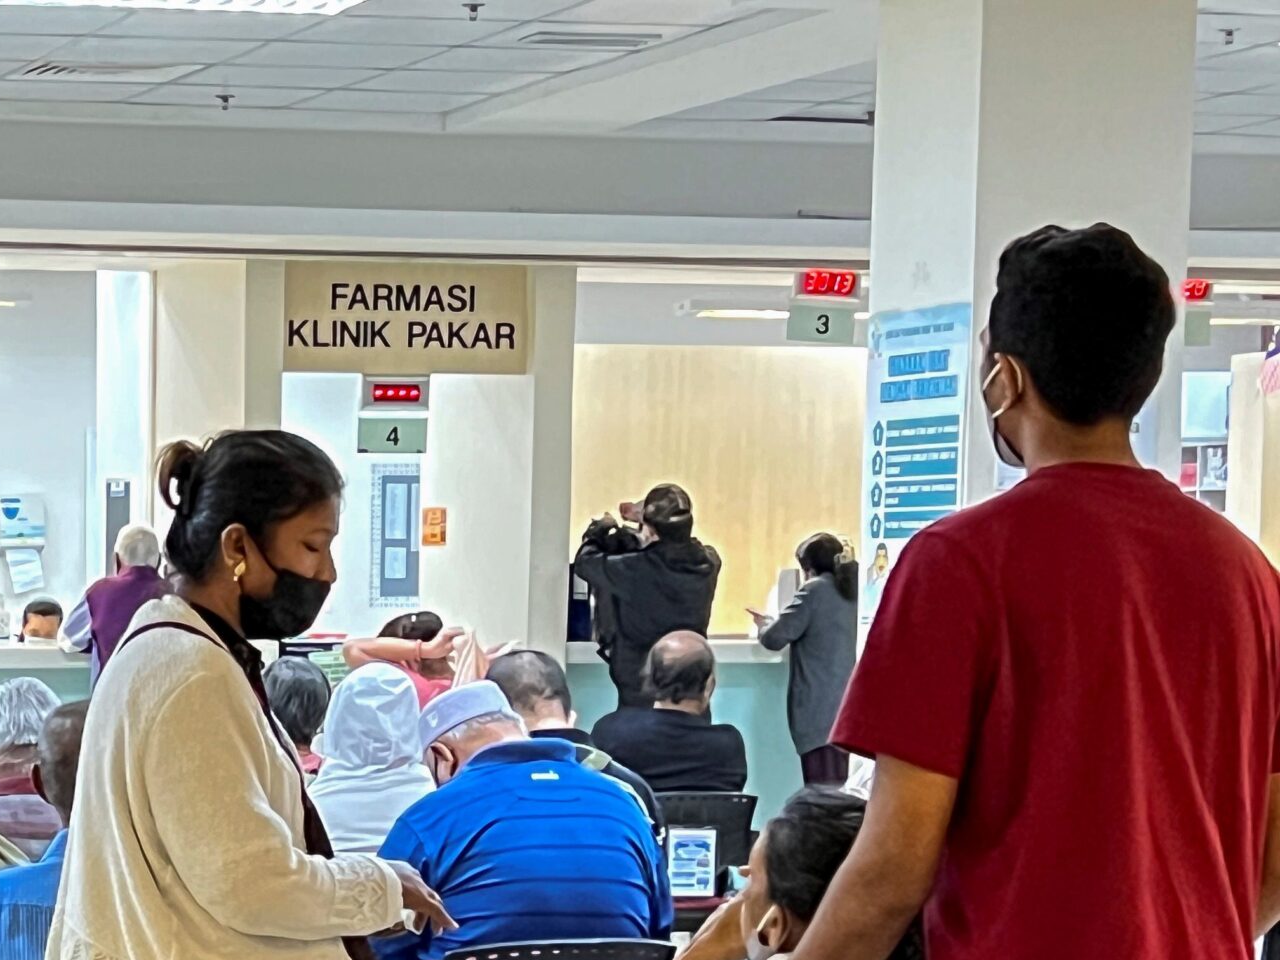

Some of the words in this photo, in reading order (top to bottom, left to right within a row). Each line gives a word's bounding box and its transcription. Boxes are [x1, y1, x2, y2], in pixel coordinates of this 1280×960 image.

[806, 271, 854, 293] 3013
[330, 282, 476, 313] FARMASI
[287, 319, 391, 348] KLINIK
[407, 321, 516, 350] PAKAR
[815, 314, 830, 335] 3
[385, 426, 400, 446] 4
